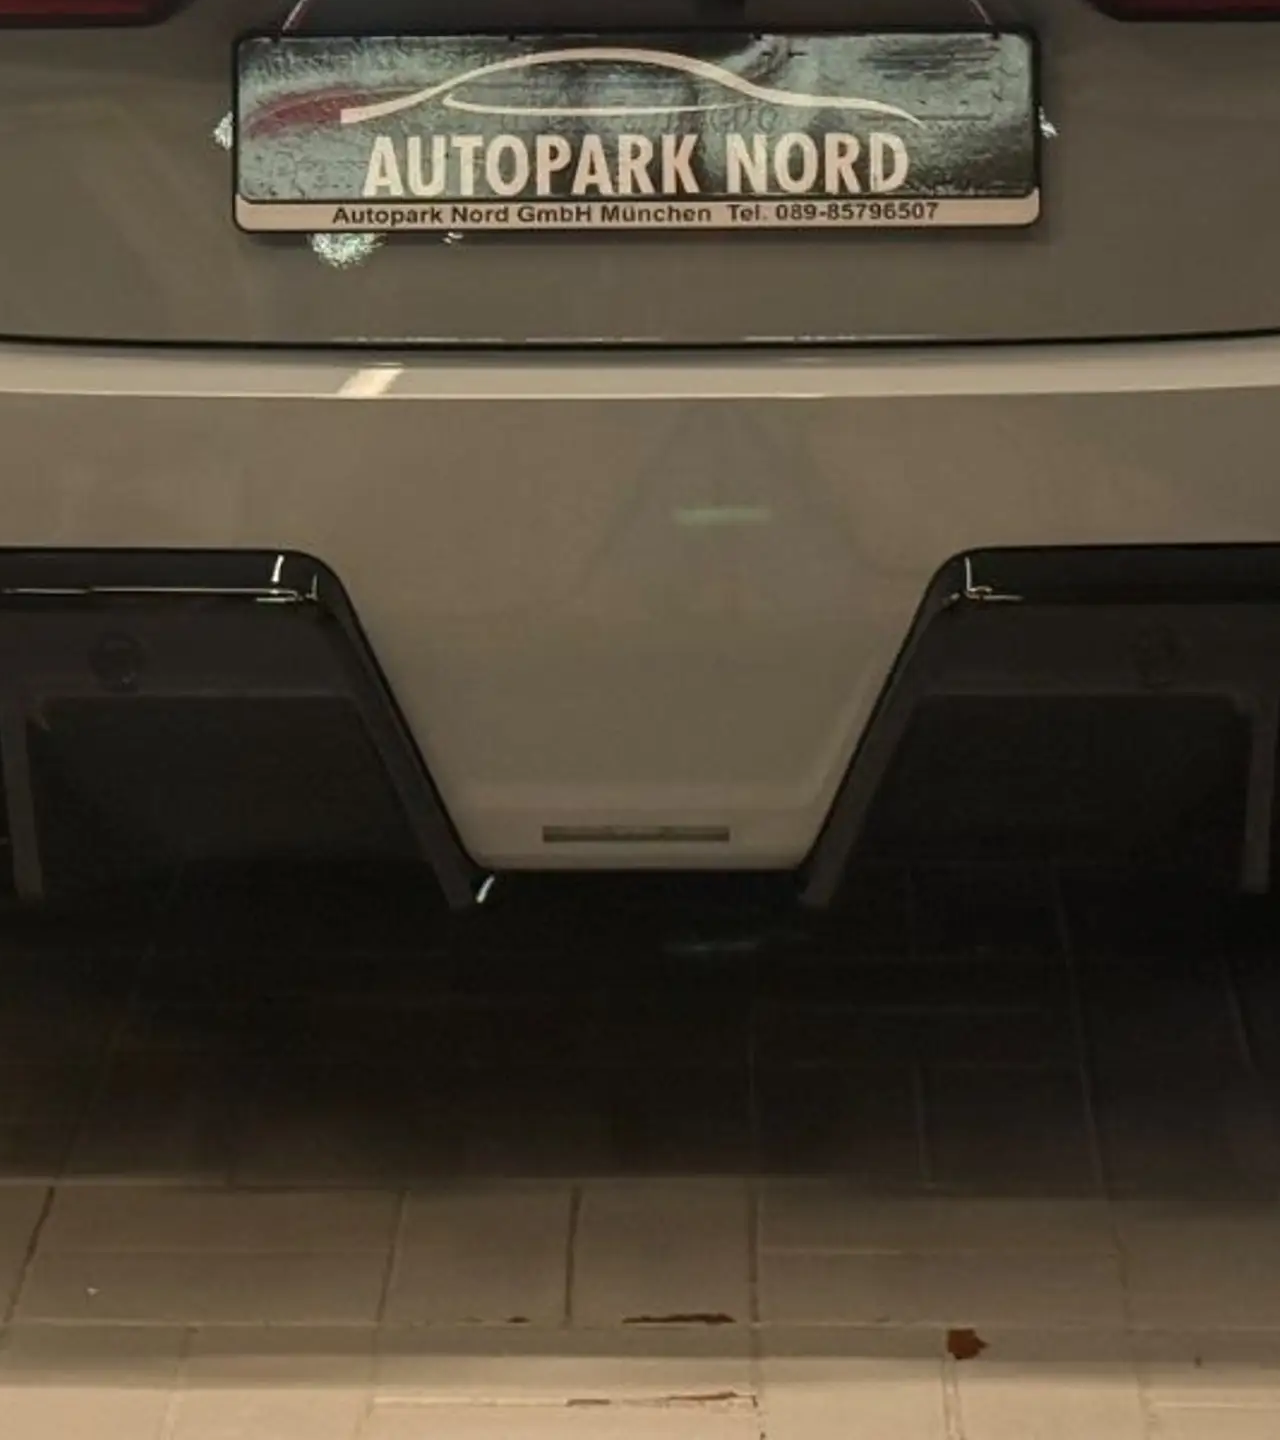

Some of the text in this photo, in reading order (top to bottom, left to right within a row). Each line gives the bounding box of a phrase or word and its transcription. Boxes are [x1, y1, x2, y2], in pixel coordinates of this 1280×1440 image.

[362, 132, 909, 198] AUTOPARK NORD
[332, 201, 940, 228] Autopark Nord GmbH München Tel. 089-85796507
